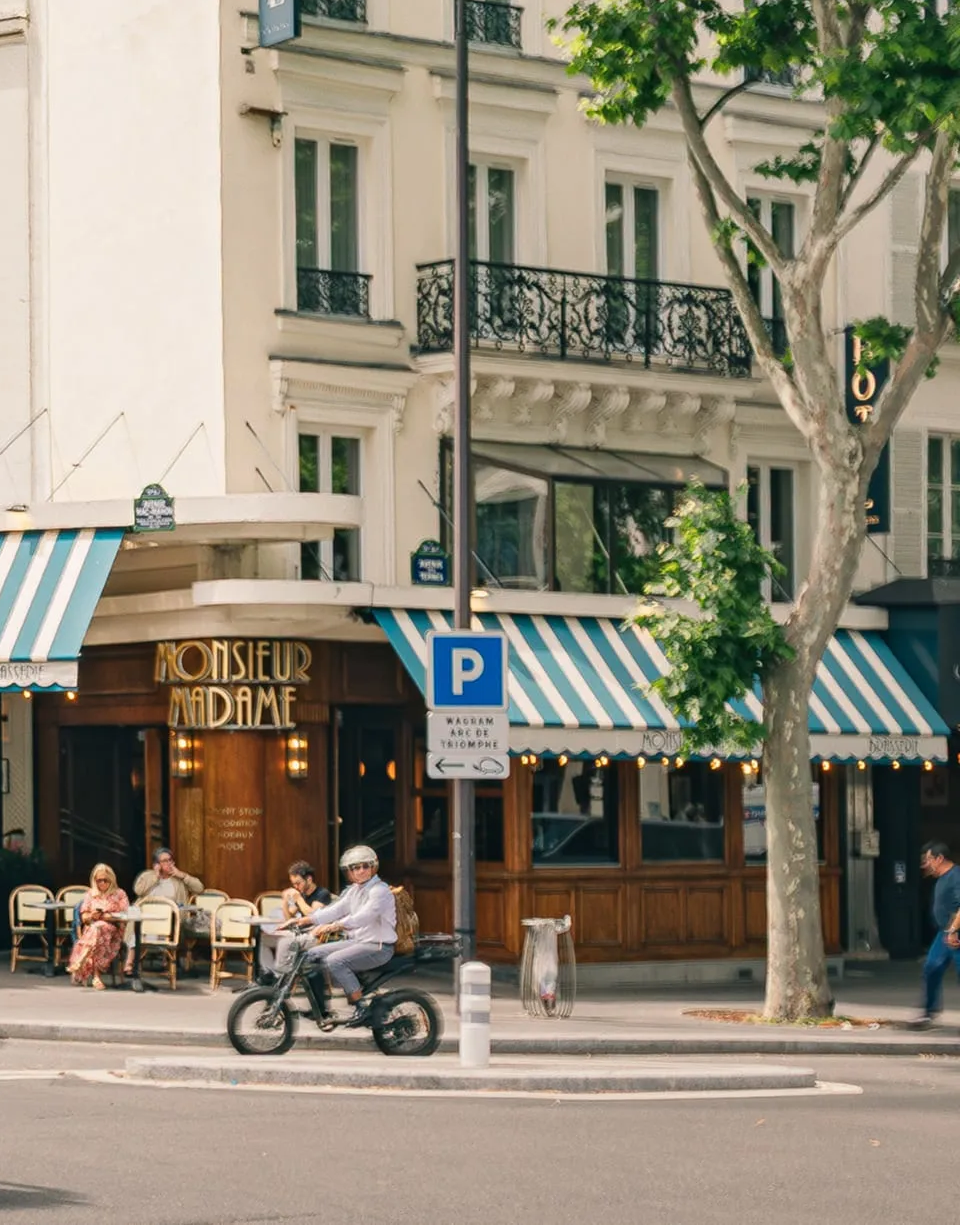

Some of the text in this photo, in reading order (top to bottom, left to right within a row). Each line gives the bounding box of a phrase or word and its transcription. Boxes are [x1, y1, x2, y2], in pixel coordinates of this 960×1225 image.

[154, 640, 312, 682] MONSIEUR
[451, 647, 484, 696] P
[168, 686, 298, 727] MADAME
[446, 717, 494, 726] WAGRAM
[450, 728, 489, 737] ARC DE
[440, 739, 500, 750] TRIOMPHE
